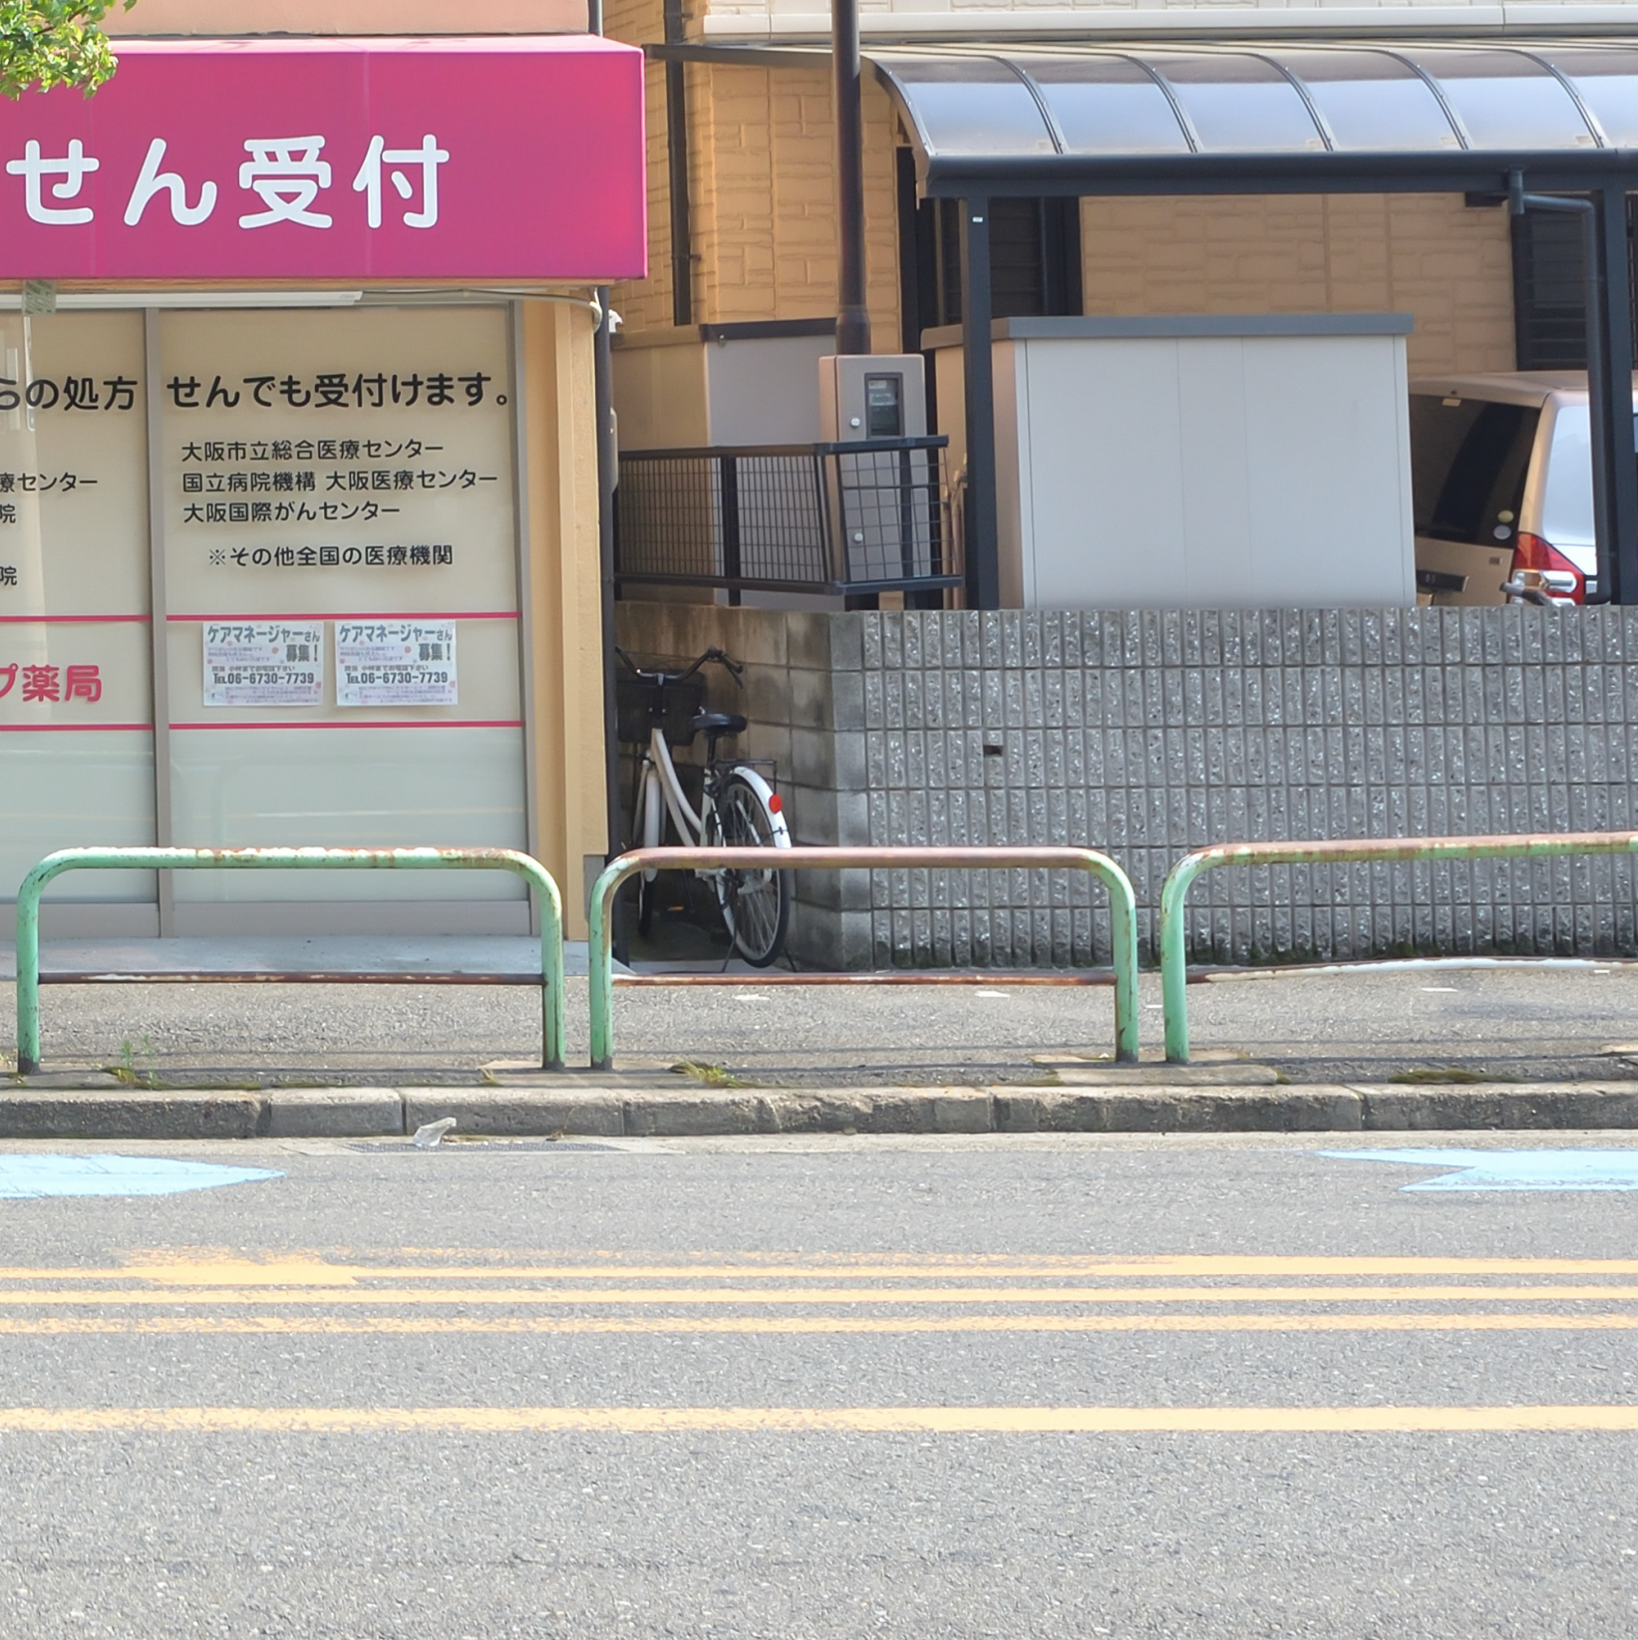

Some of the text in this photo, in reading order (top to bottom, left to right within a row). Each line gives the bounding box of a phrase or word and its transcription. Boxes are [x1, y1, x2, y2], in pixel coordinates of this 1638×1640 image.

[165, 372, 509, 410] せんでも受付けます。
[181, 438, 444, 462] 大阪市立総合医療センター
[182, 469, 498, 493] 国立病院機構 大阪医療センター
[183, 500, 400, 523] 大阪国際がんセンター
[209, 544, 453, 567] ※その他全国の医療機関
[208, 625, 321, 643] ケアマネージャーさん
[340, 624, 453, 642] ケアマネージャーさん
